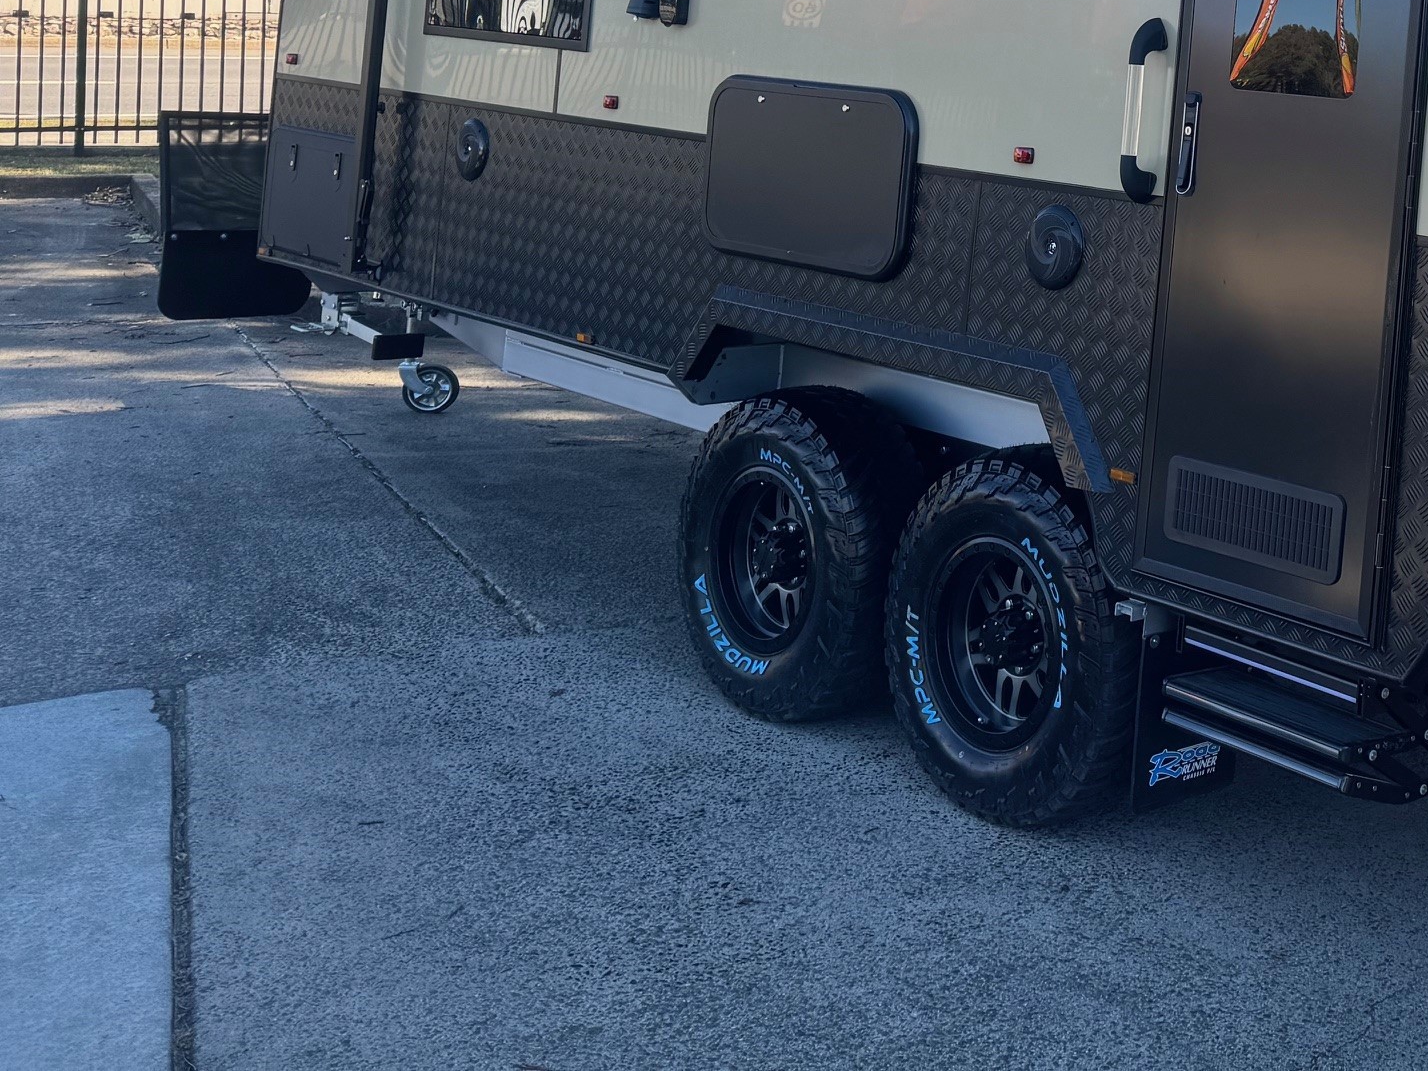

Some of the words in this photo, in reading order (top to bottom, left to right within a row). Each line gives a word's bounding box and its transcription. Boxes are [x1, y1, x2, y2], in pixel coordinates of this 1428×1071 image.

[694, 573, 771, 676] MUDZILLA
[905, 604, 942, 726] MPC-M/T
[1021, 537, 1069, 710] MUDZILLA
[1181, 756, 1218, 776] RUNNER
